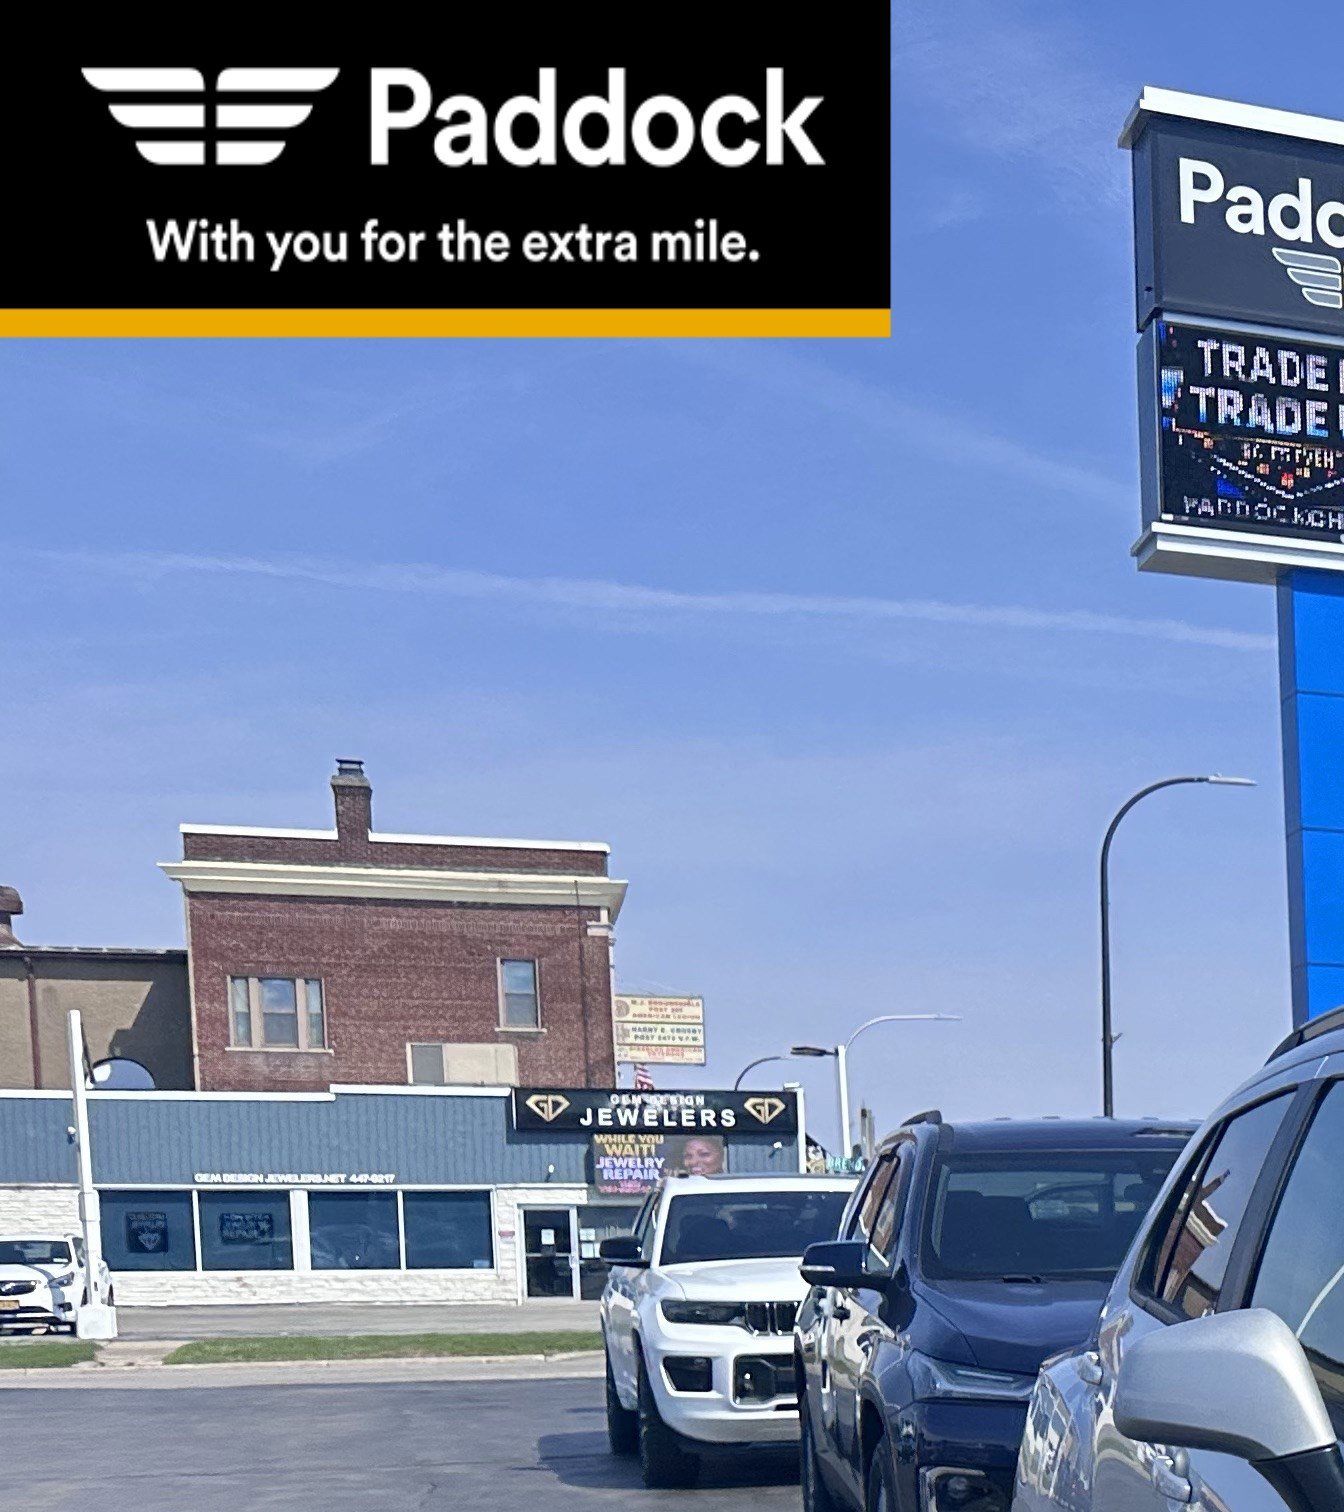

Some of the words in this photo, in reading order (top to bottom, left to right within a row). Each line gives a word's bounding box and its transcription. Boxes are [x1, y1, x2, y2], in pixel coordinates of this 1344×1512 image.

[1198, 339, 1329, 392] TRADE
[1190, 386, 1329, 438] TRADE
[579, 1107, 737, 1128] JEWELERS
[593, 1134, 635, 1144] WHILE
[638, 1134, 664, 1144] YOU
[595, 1156, 666, 1169] JEWELRY
[603, 1168, 660, 1180] REPAIR
